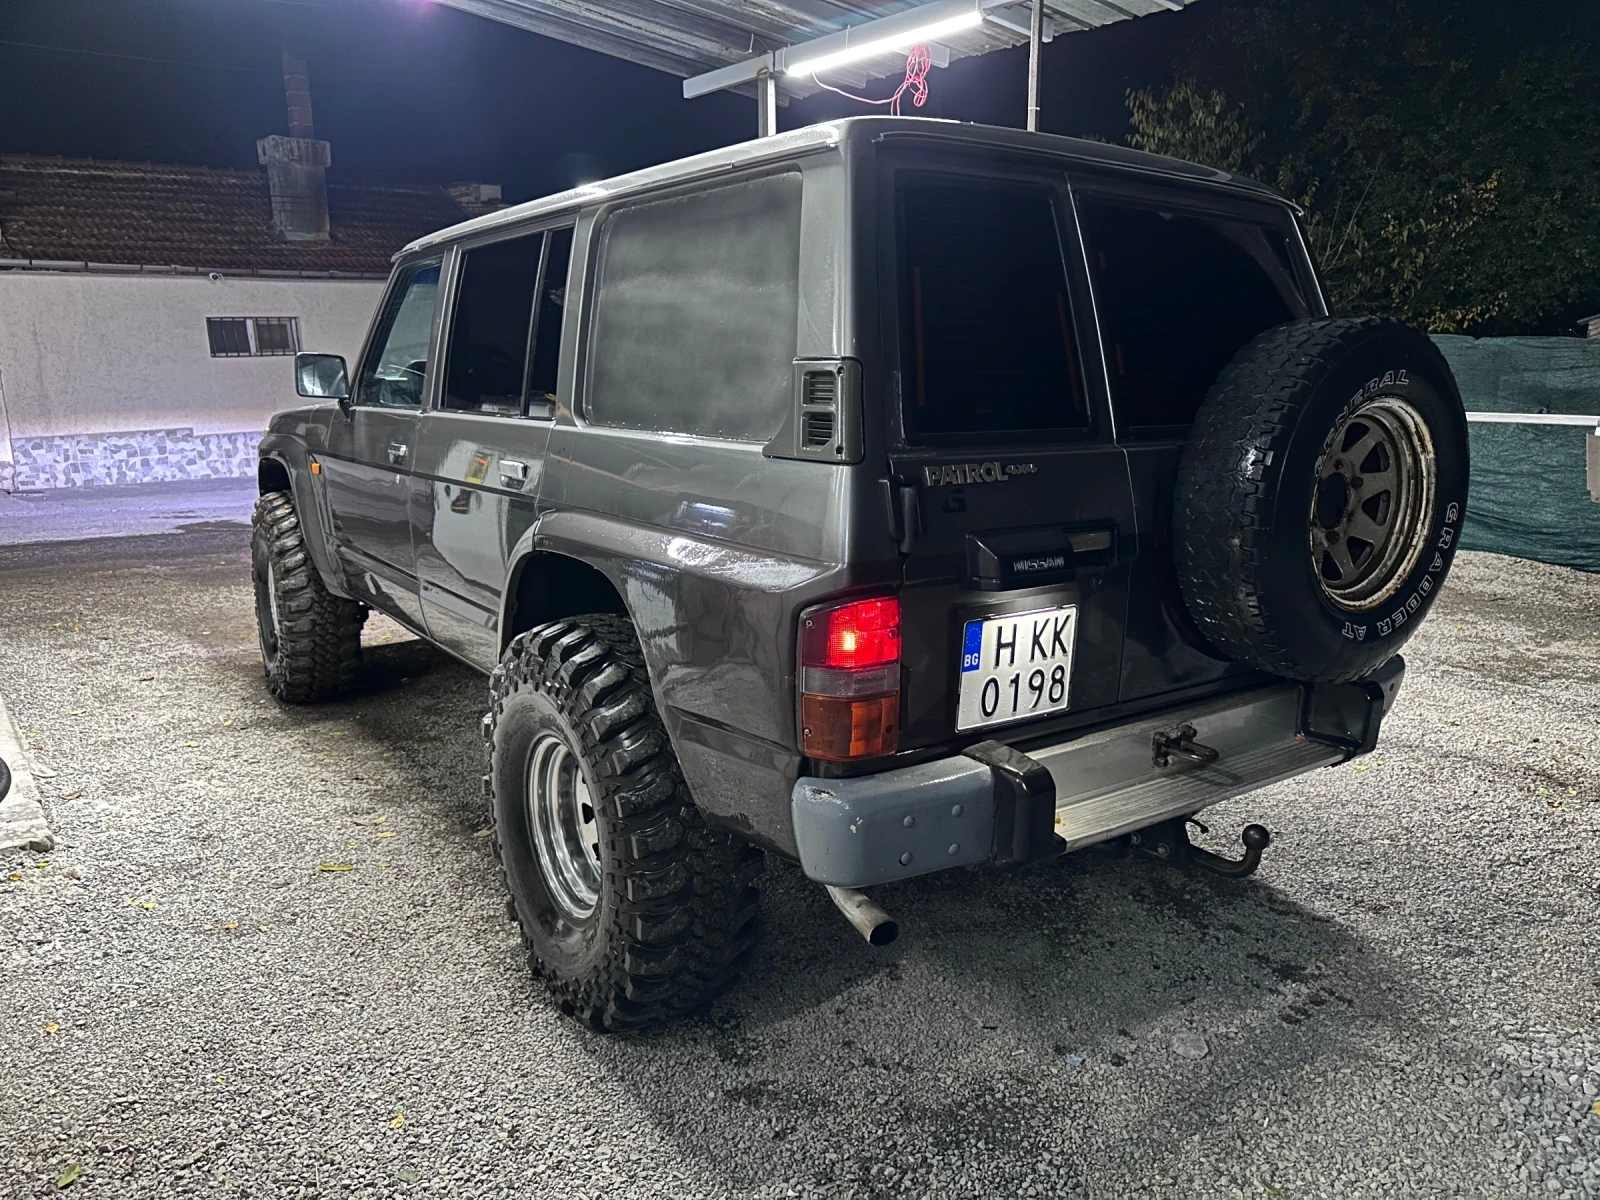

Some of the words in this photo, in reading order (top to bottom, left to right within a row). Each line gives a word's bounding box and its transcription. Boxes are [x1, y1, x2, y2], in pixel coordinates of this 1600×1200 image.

[923, 461, 1009, 487] PATROL
[1013, 556, 1065, 572] NISSAN
[1377, 502, 1459, 636] GRABBER
[994, 623, 1018, 669] H
[1030, 614, 1071, 662] KK
[1342, 621, 1367, 640] AT
[963, 652, 980, 668] BG
[980, 664, 1066, 718] 0198
